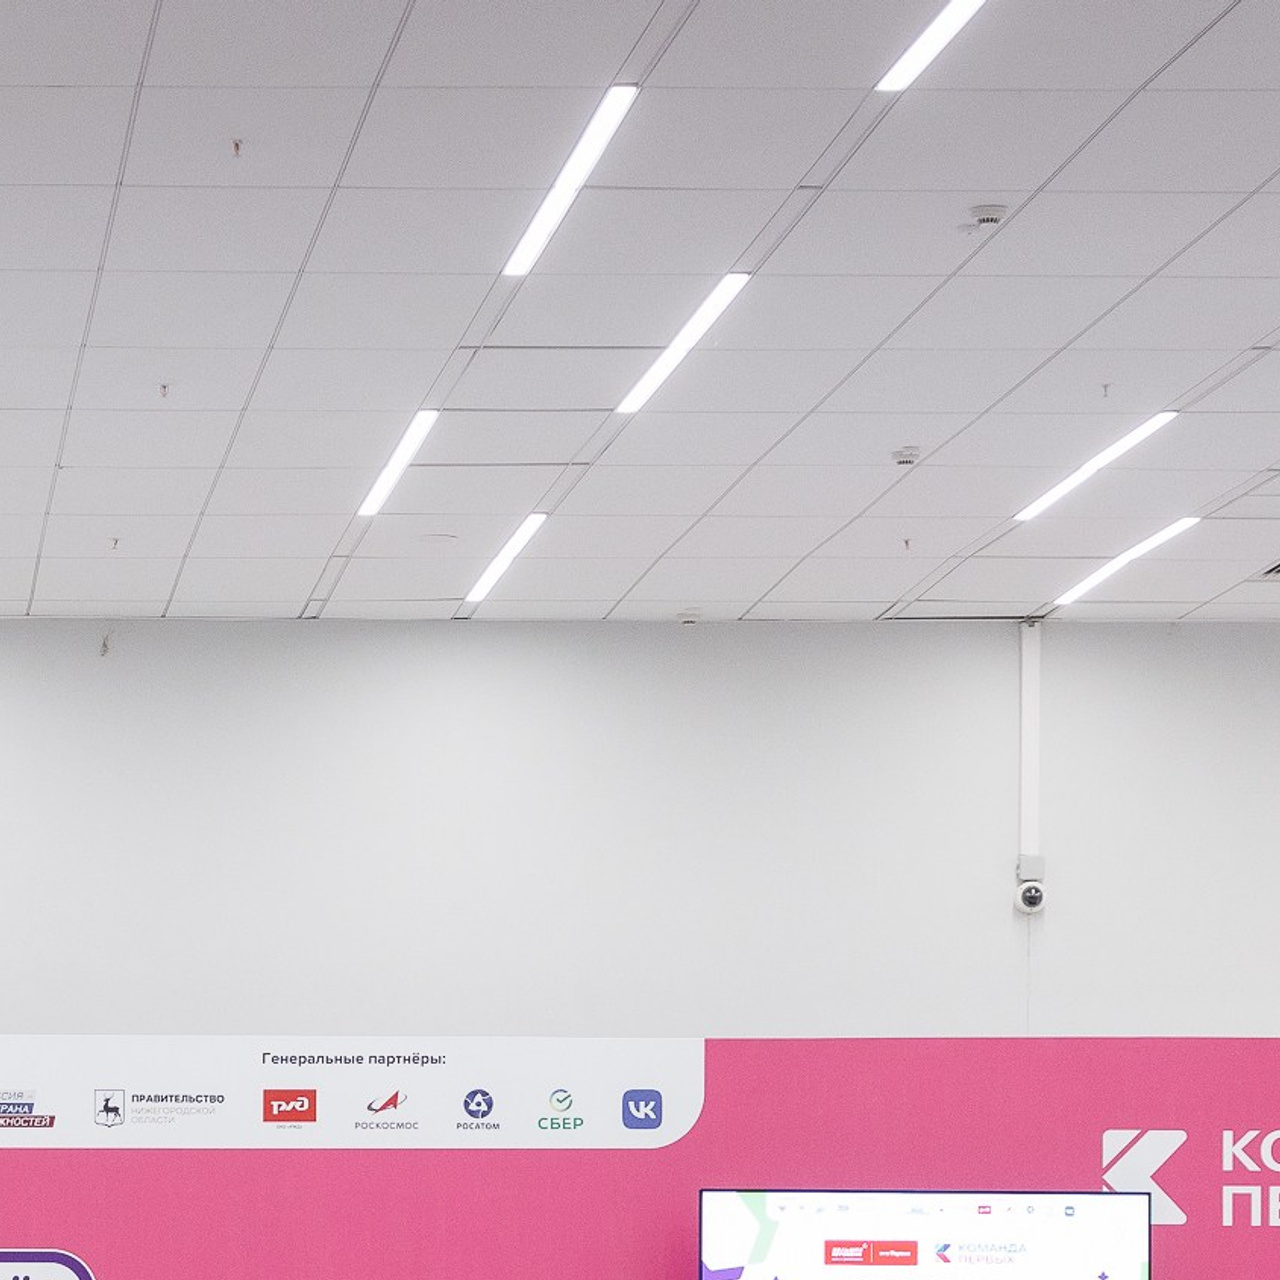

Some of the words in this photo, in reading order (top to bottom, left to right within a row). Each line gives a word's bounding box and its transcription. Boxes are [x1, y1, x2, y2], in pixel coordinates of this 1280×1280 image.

[262, 1052, 364, 1067] Генеральные
[368, 1052, 446, 1067] партнёры:
[131, 1094, 225, 1104] ПРАВИТЕЛЬСТВО
[355, 1122, 419, 1130] РОСКОСМОС
[538, 1117, 584, 1130] СБЕР
